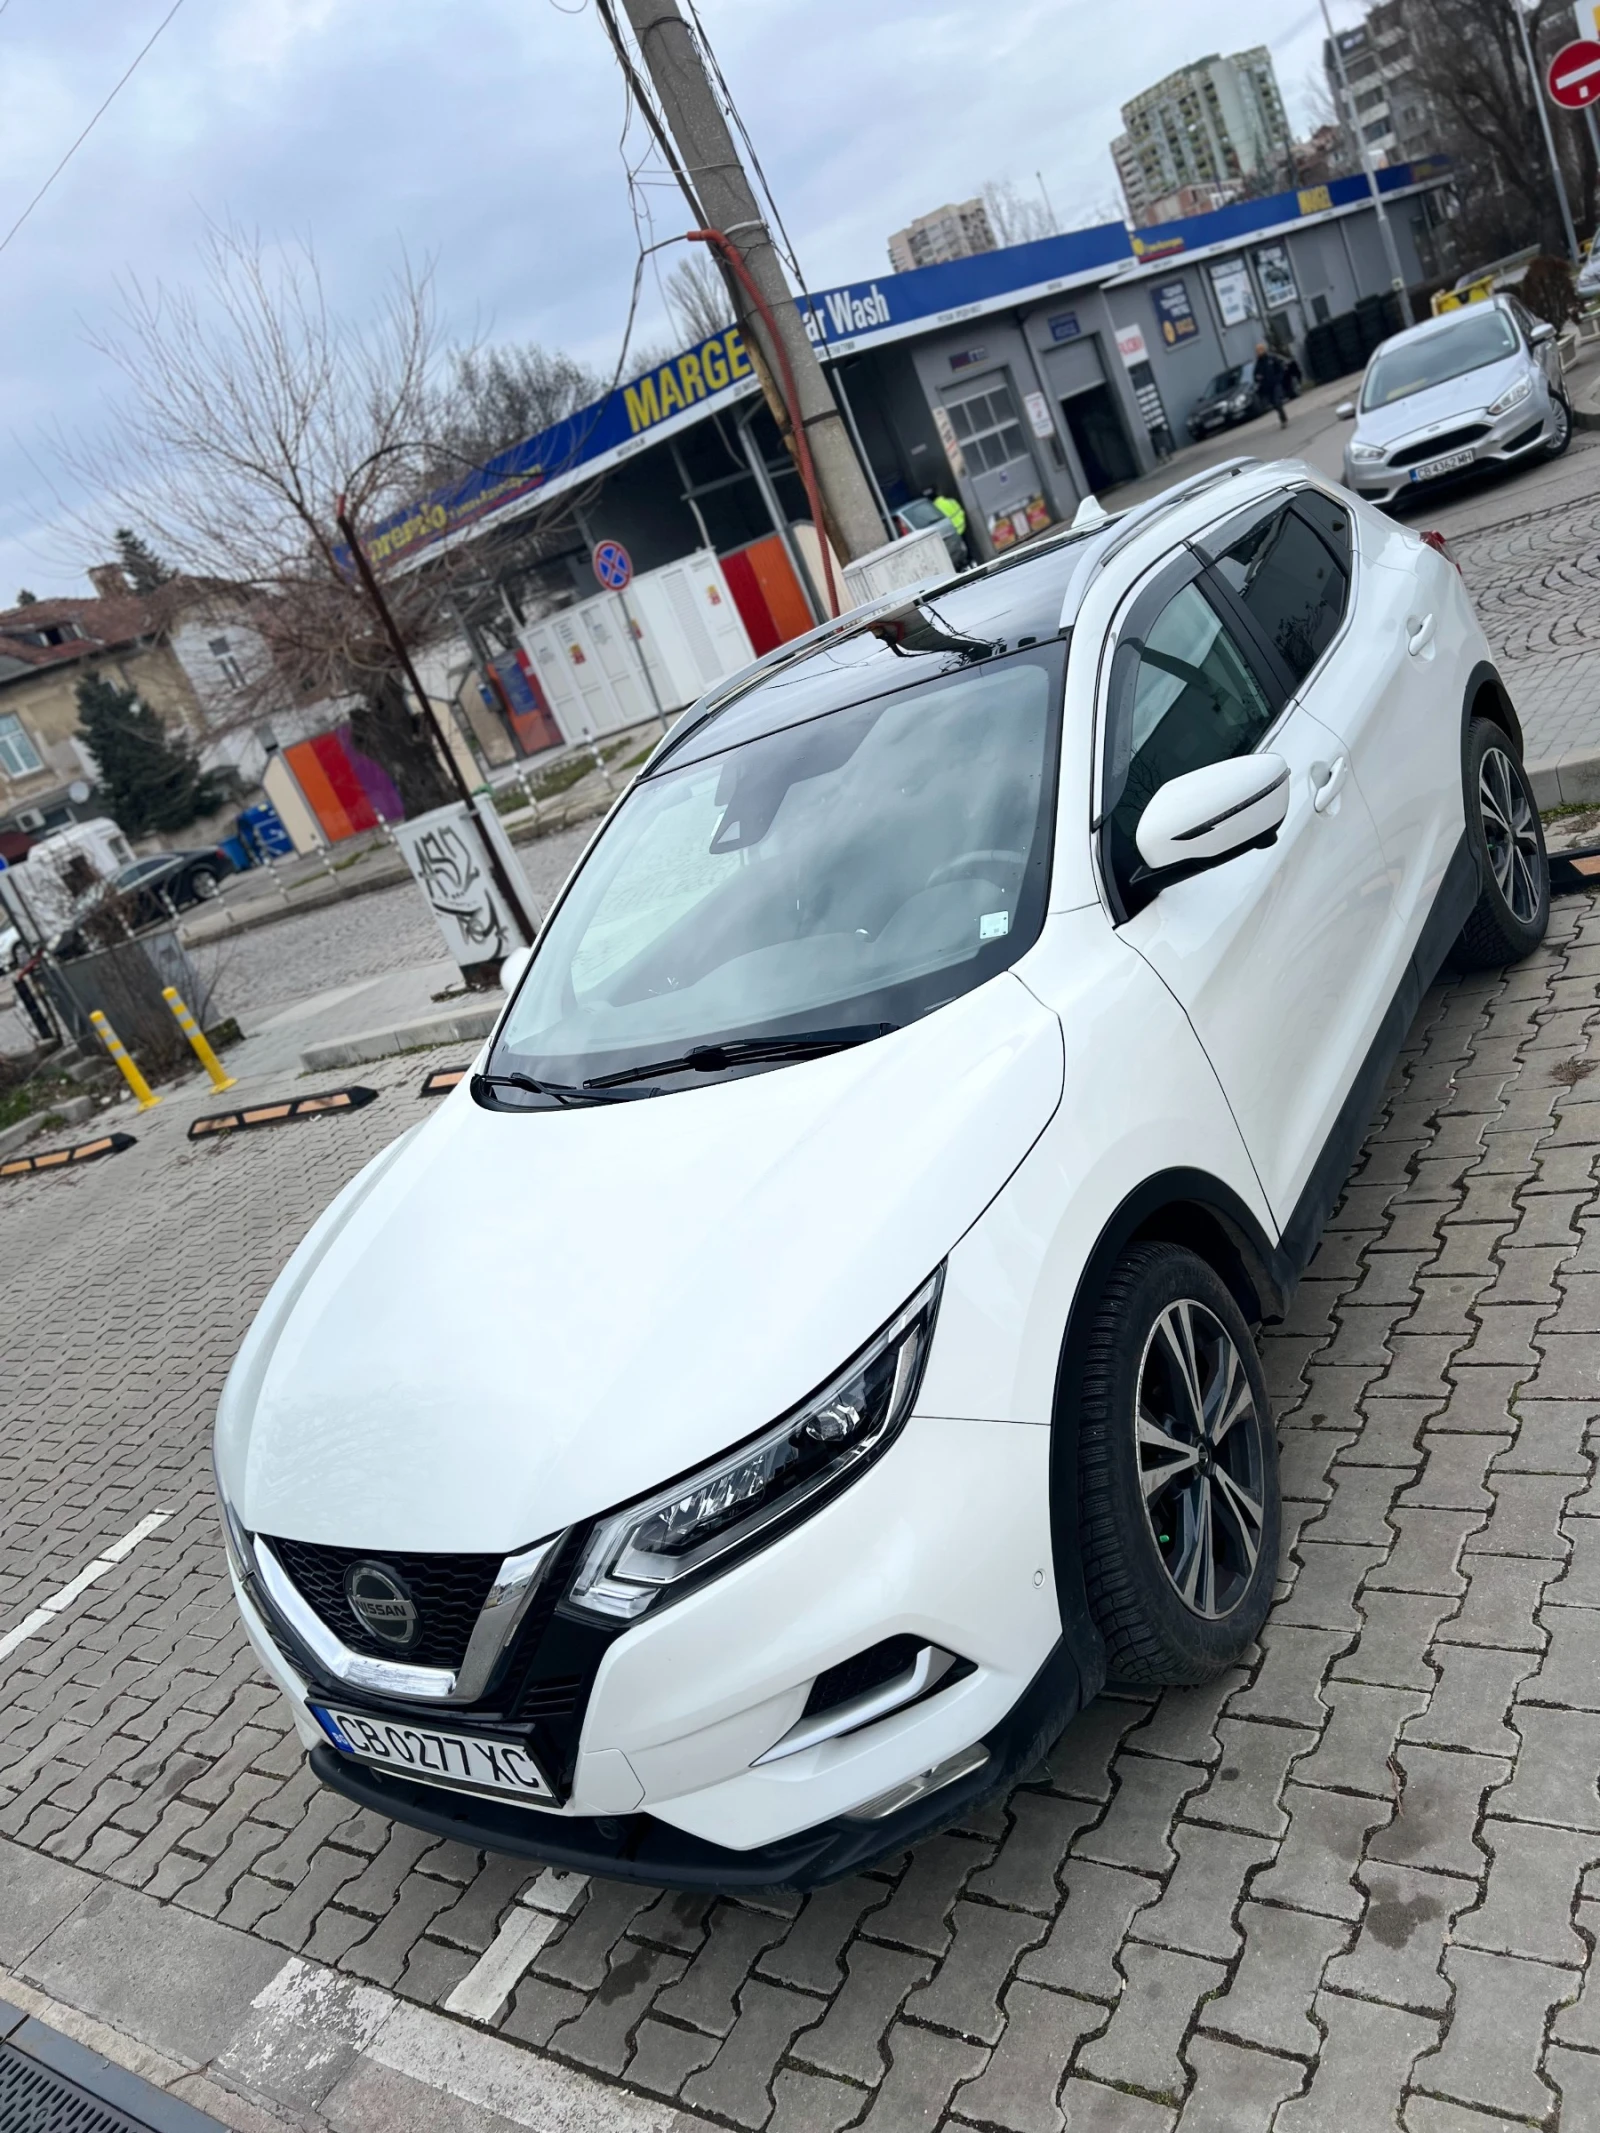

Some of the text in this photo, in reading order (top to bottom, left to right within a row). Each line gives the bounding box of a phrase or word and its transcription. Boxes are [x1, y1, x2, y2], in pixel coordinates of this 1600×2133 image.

[802, 309, 828, 342] ar
[824, 283, 891, 334] Wash
[623, 328, 753, 433] MARGE
[356, 1601, 407, 1617] NISSAN
[332, 1732, 348, 1745] BG
[385, 1726, 472, 1776] 0277
